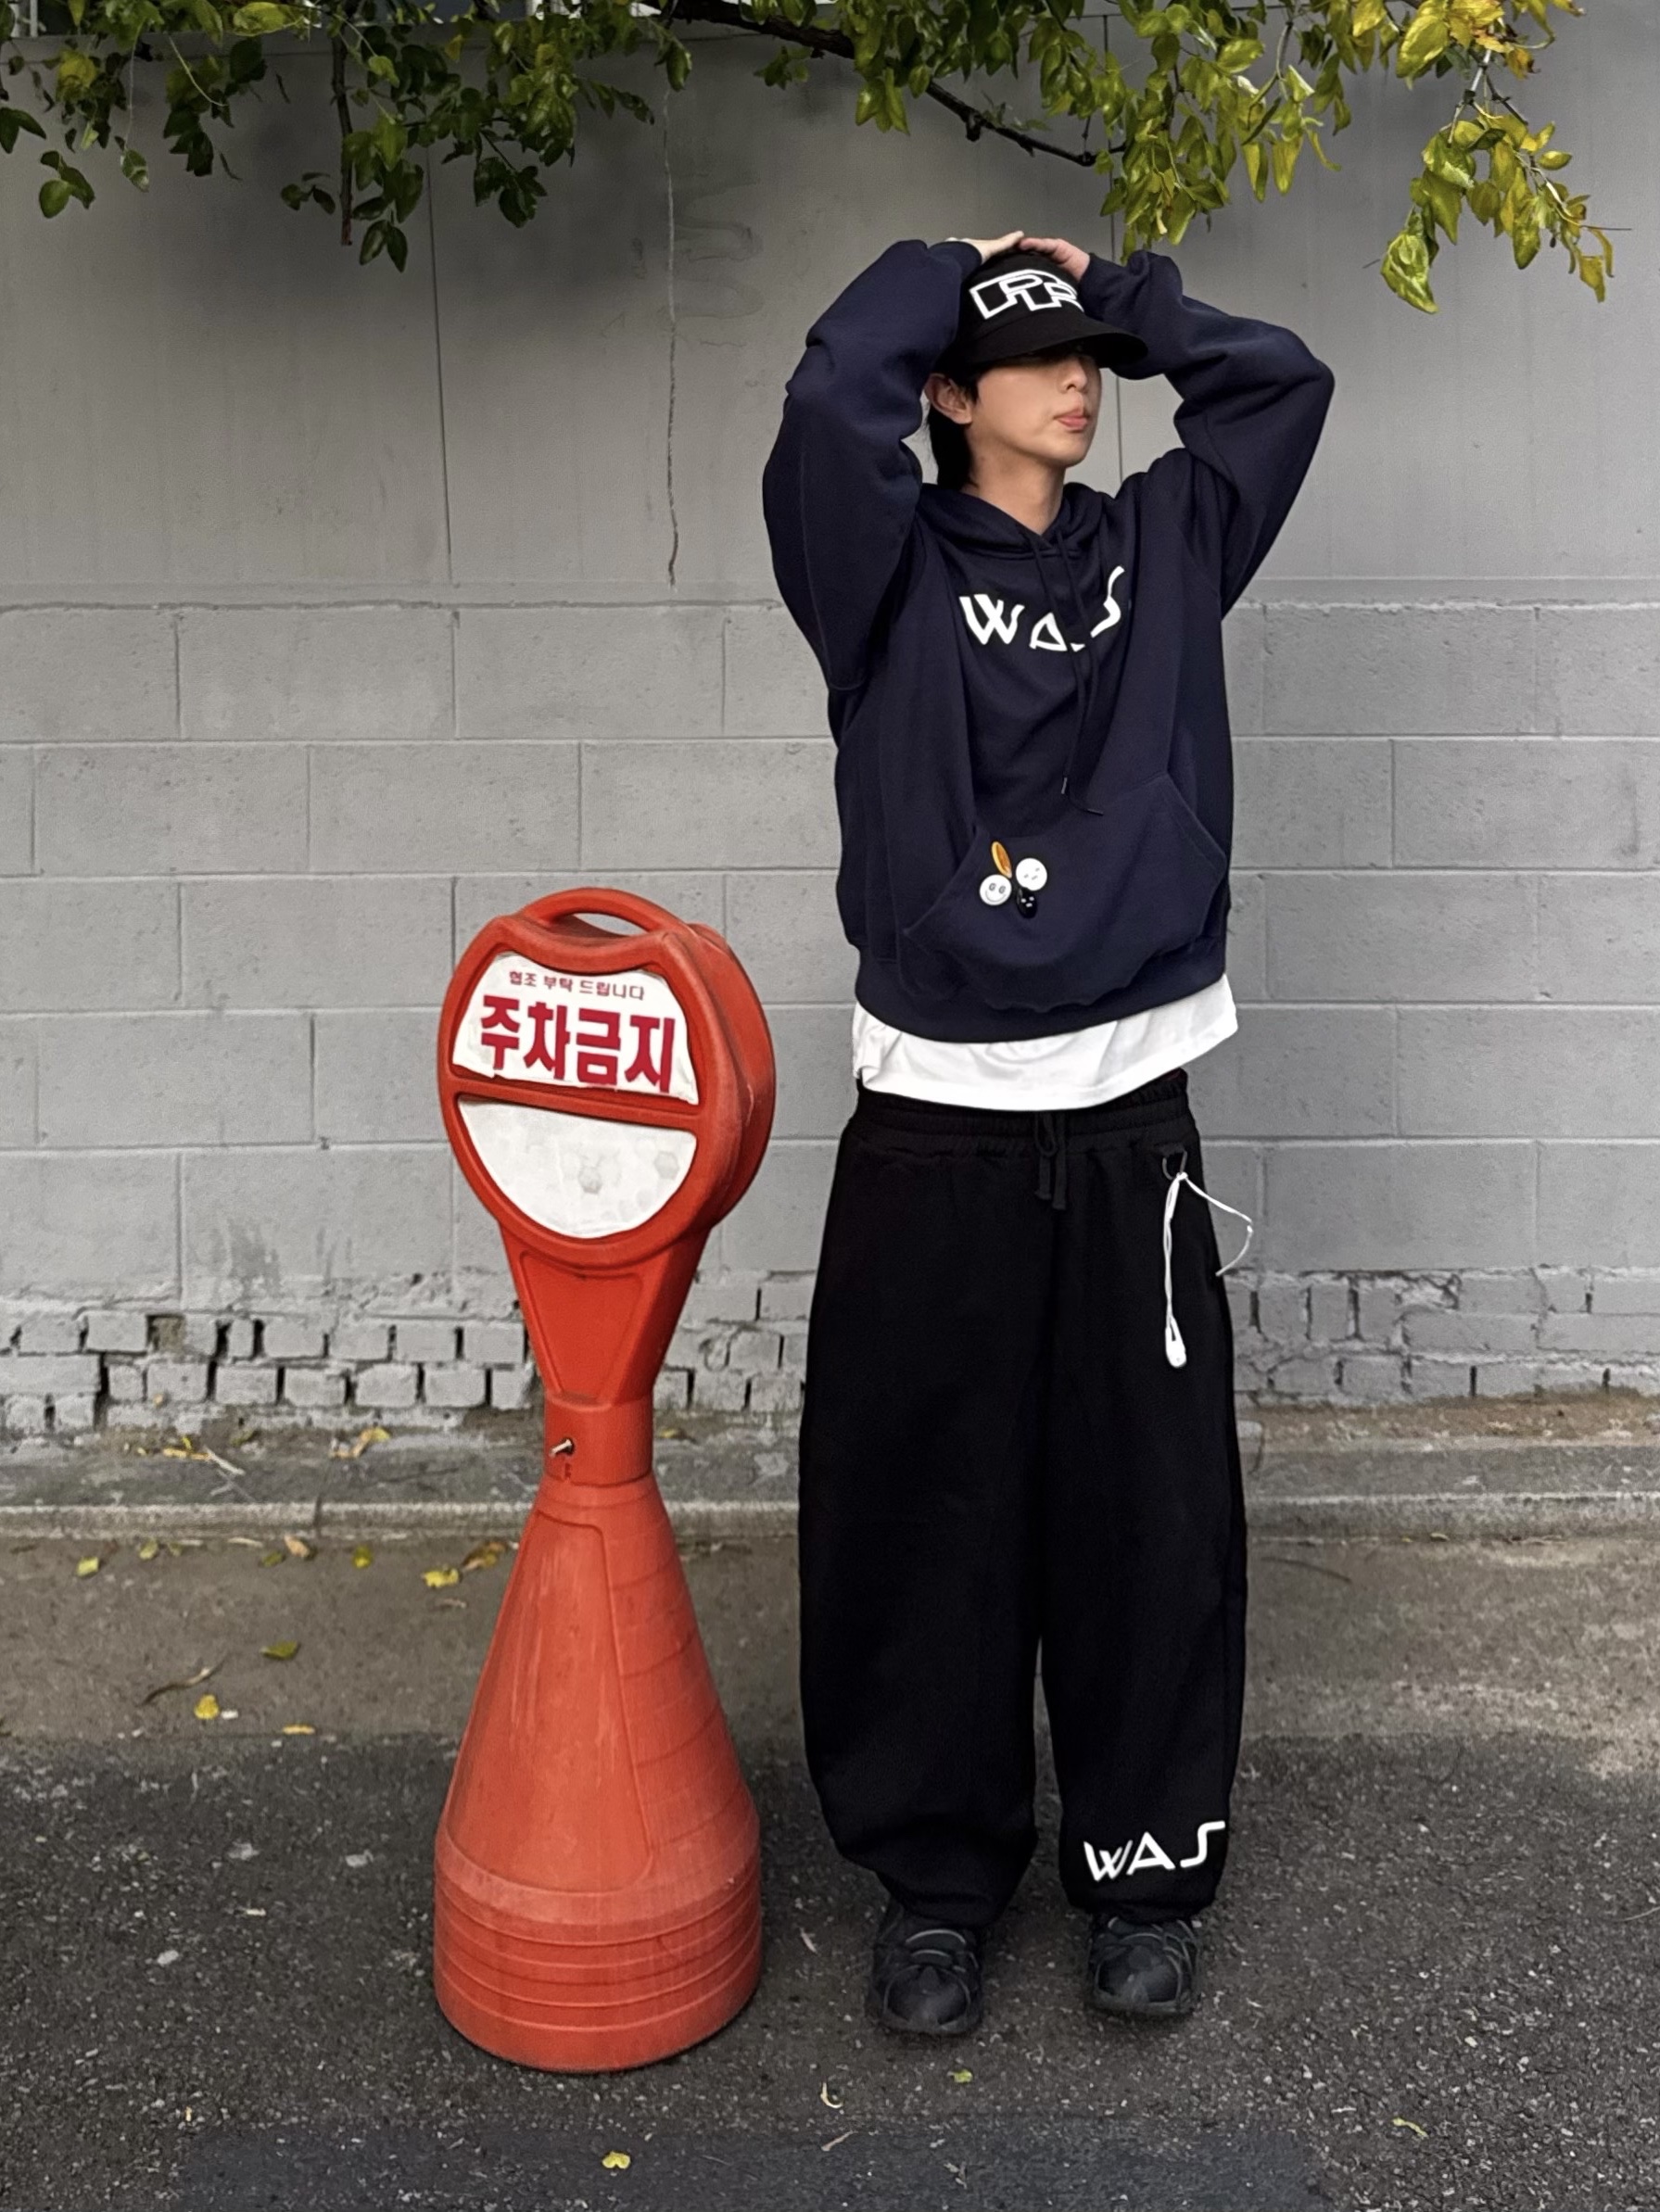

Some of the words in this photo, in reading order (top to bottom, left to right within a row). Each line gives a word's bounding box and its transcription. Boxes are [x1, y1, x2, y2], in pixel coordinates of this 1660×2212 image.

[510, 971, 537, 987] 협조
[544, 976, 573, 992] 부탁
[579, 980, 645, 1001] 드립니다
[481, 994, 676, 1093] 주차금지
[1083, 1820, 1226, 1882] WAS
